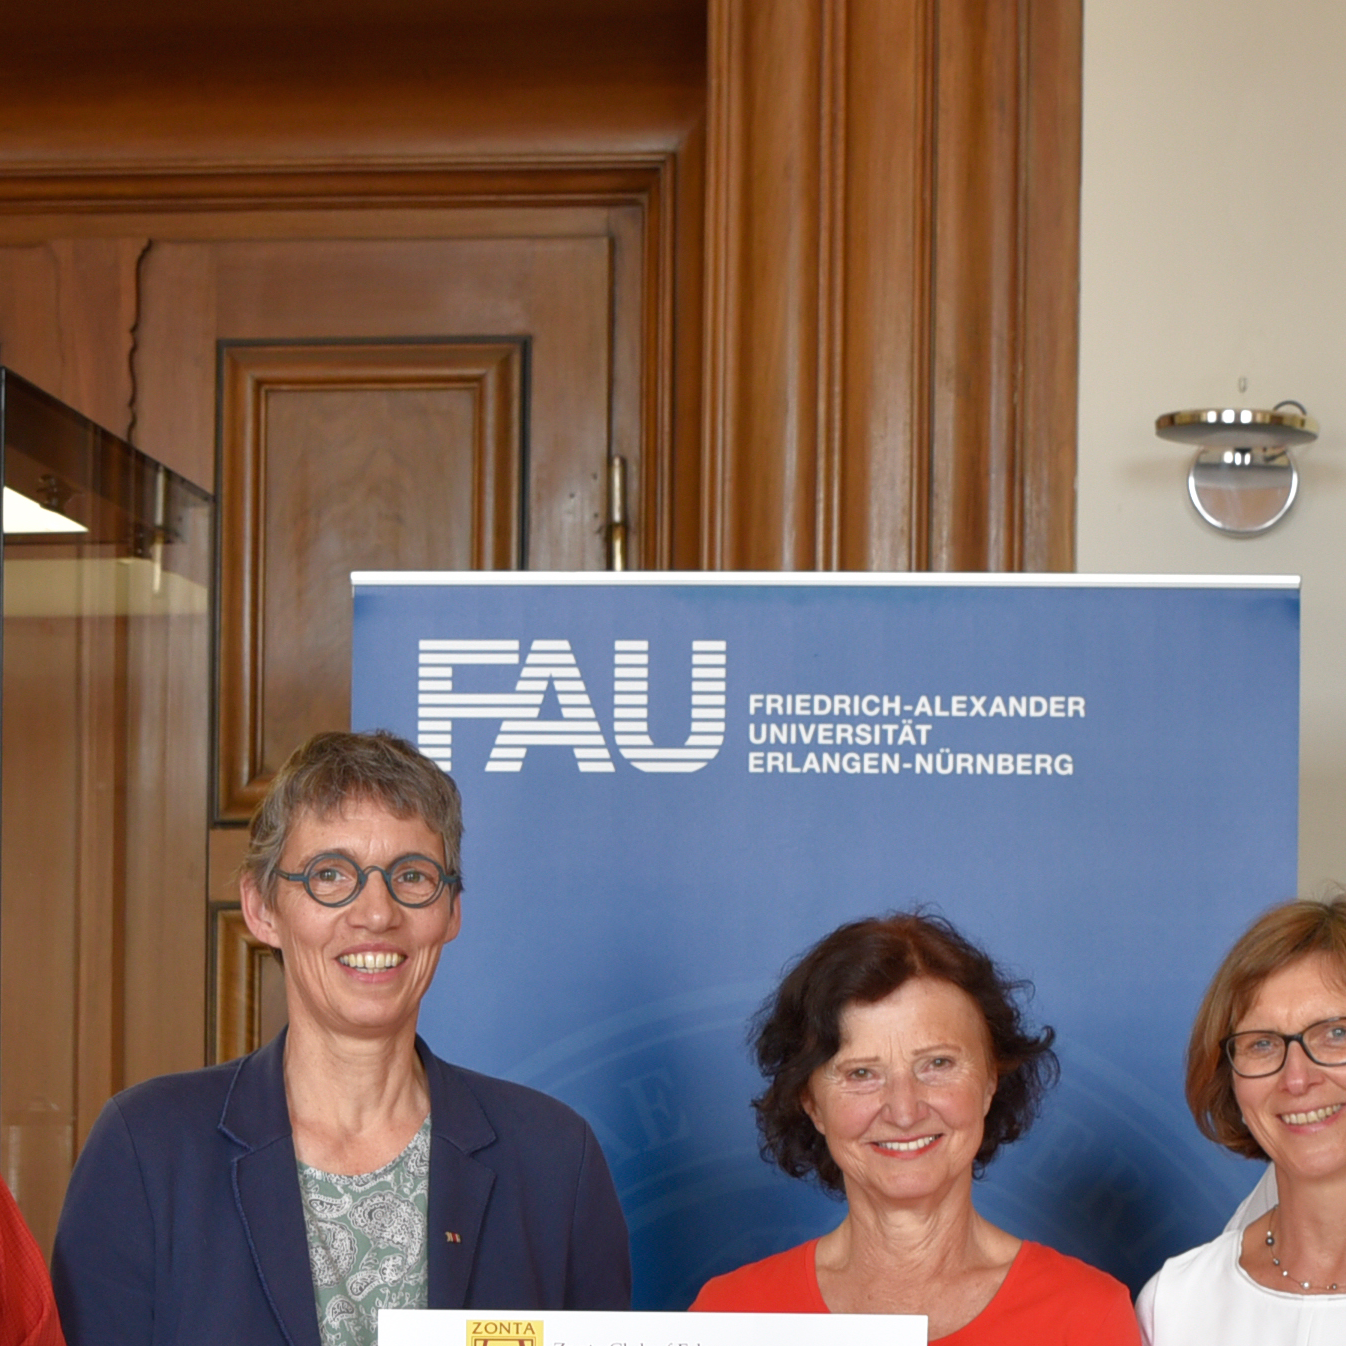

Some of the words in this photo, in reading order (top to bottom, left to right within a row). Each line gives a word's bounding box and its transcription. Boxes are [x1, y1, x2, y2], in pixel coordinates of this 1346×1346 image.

[417, 639, 726, 773] FAU
[748, 694, 1086, 718] FRIEDRICH-ALEXANDER
[748, 719, 932, 746] UNIVERSITÄT
[748, 748, 1075, 776] ERLANGEN-NÜRNBERG
[472, 1322, 535, 1334] ZONTA
